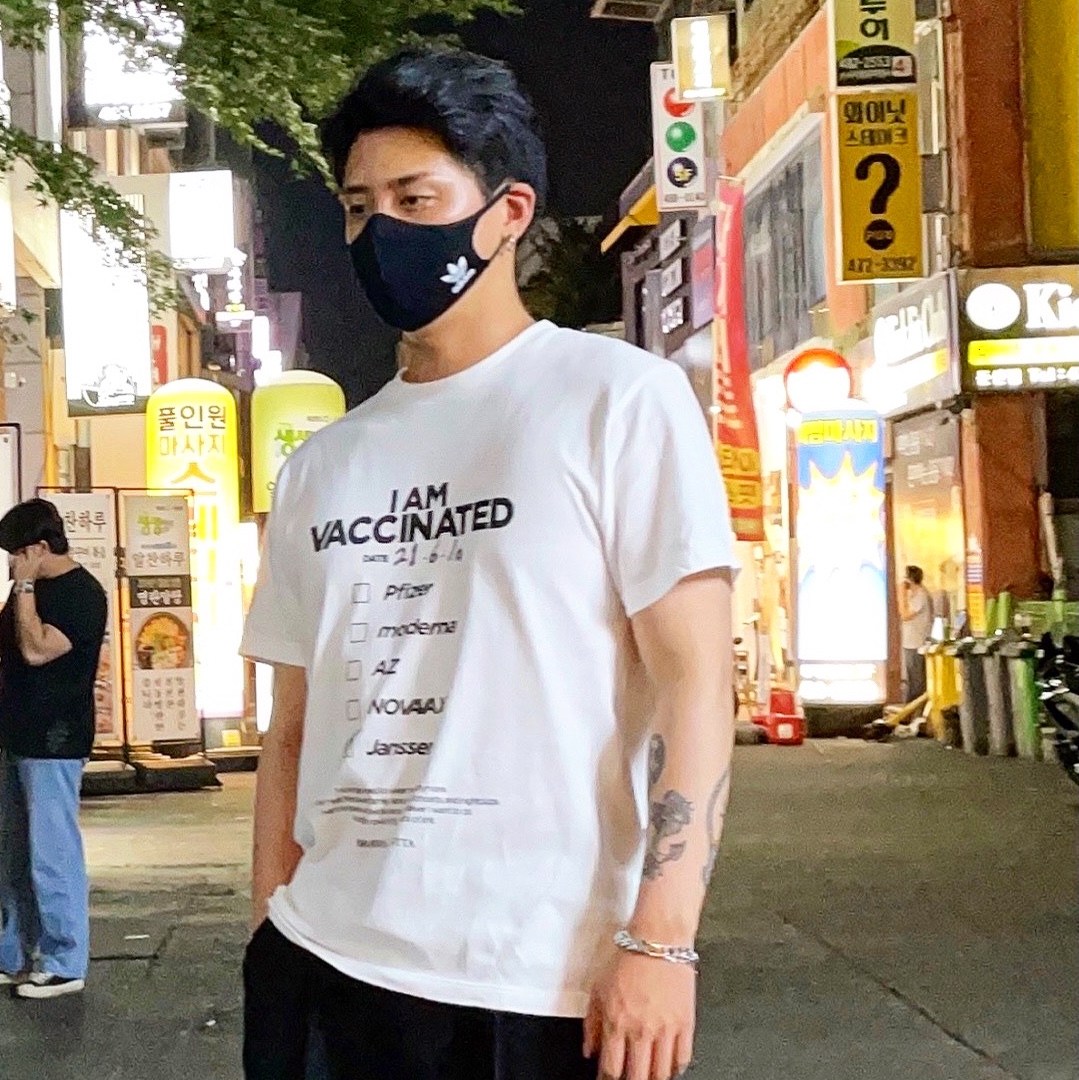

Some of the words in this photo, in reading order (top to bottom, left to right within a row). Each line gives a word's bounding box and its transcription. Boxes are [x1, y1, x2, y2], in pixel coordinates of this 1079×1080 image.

[158, 434, 226, 458] 마사지
[391, 490, 399, 513] I
[402, 482, 449, 511] AM
[64, 510, 107, 533] 찬하루
[311, 498, 514, 552] VACCINATED
[371, 658, 400, 675] AZ
